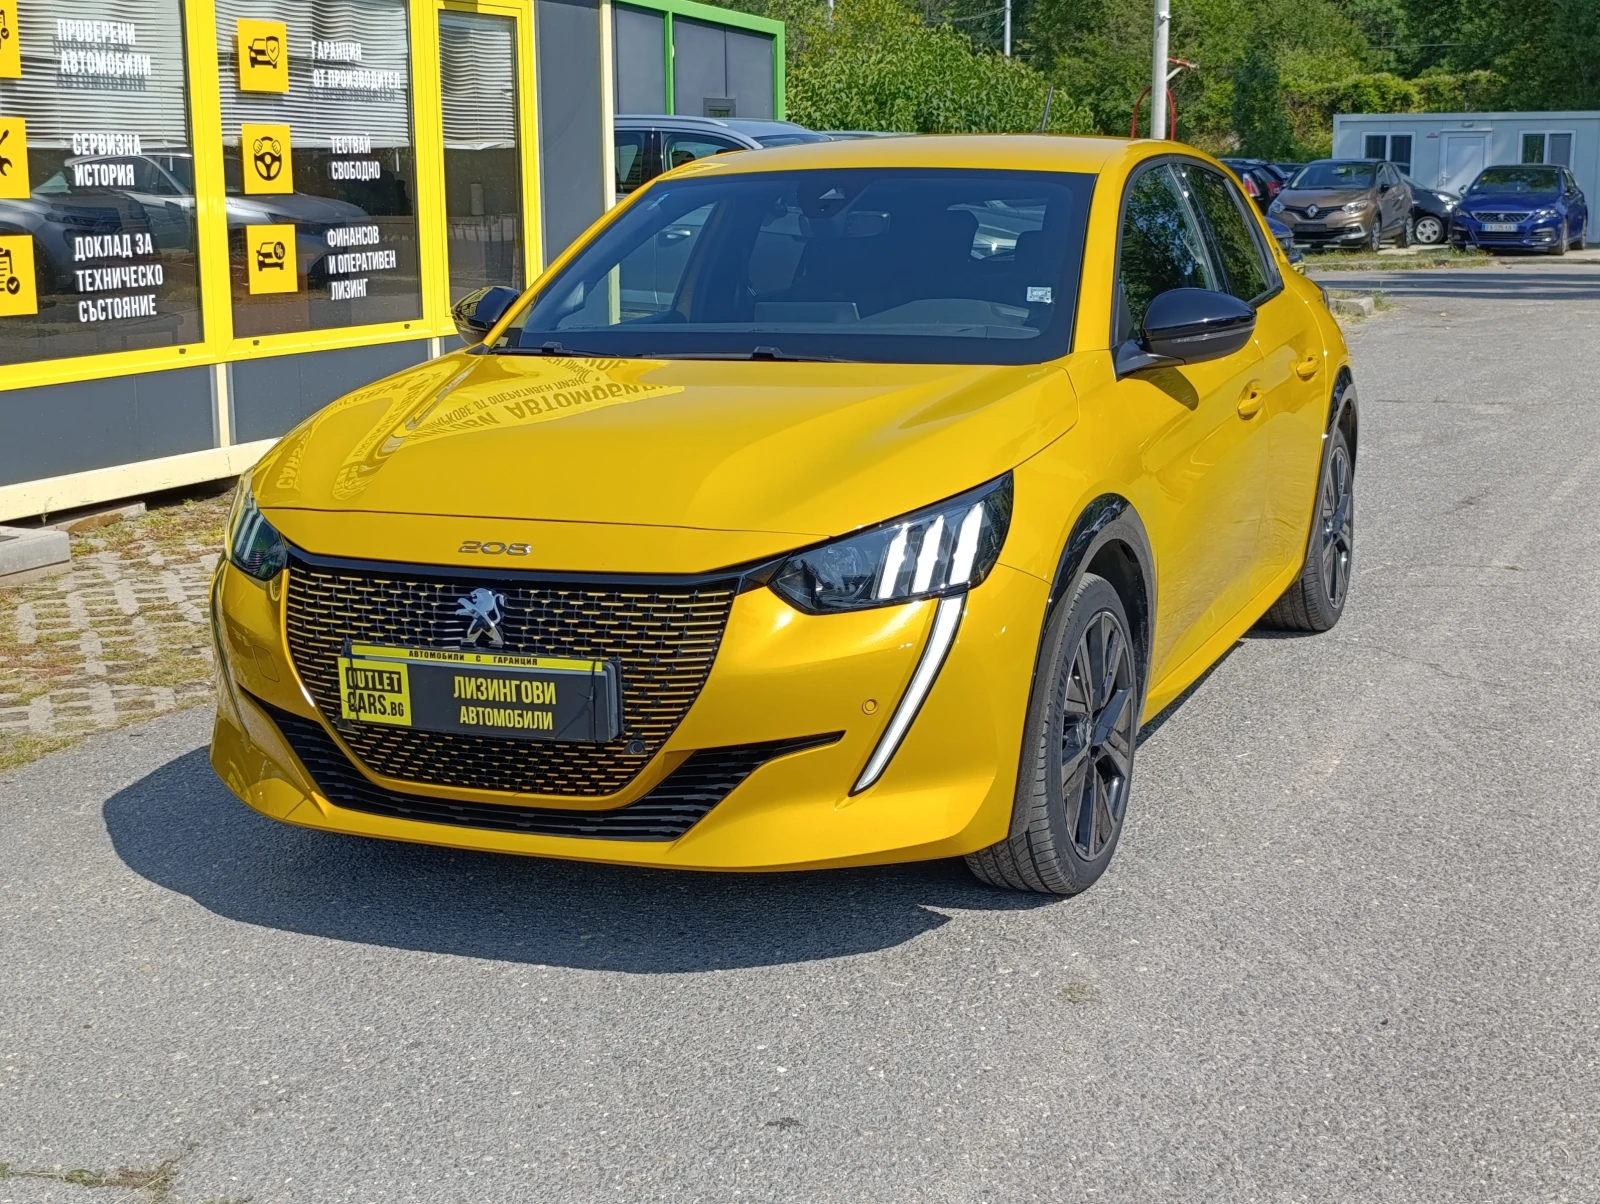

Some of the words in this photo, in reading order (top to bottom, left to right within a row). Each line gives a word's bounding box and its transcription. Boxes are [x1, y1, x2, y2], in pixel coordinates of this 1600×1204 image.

[57, 19, 136, 45] ПРОВЕРЕНИ
[311, 40, 362, 62] ГАРАНЦИЯ
[60, 51, 151, 76] АВТОМОБИЛИ
[313, 69, 325, 88] ОТ
[327, 69, 401, 91] ПРОИЗВОДИТЕЛ
[72, 133, 142, 156] СЕРВИЗНА
[329, 132, 371, 154] ТЕСТВАЙ
[75, 164, 135, 187] ИСТОРИЯ
[331, 160, 381, 182] СВОБОДНО
[74, 234, 132, 262] ДОКЛАД
[135, 233, 154, 255] ЗА
[327, 225, 379, 248] ФИНАНСОВ
[328, 254, 337, 275] И
[337, 249, 397, 274] ОПЕРАТИВЕН
[76, 264, 163, 293] ТЕХНИЧЕСКО
[331, 278, 368, 301] ЛИЗИНГ
[78, 294, 157, 323] СЪСТОЯНИЕ
[458, 540, 532, 556] 208
[408, 650, 465, 661] АВТОМОБИЛИ
[493, 656, 538, 666] ГАРАНЦИЯ
[348, 669, 399, 692] OUTLET
[453, 676, 557, 705] ЛИЗИНГОВИ
[347, 691, 405, 718] CARS.BG
[460, 705, 553, 731] АВТОМОБИЛИ
